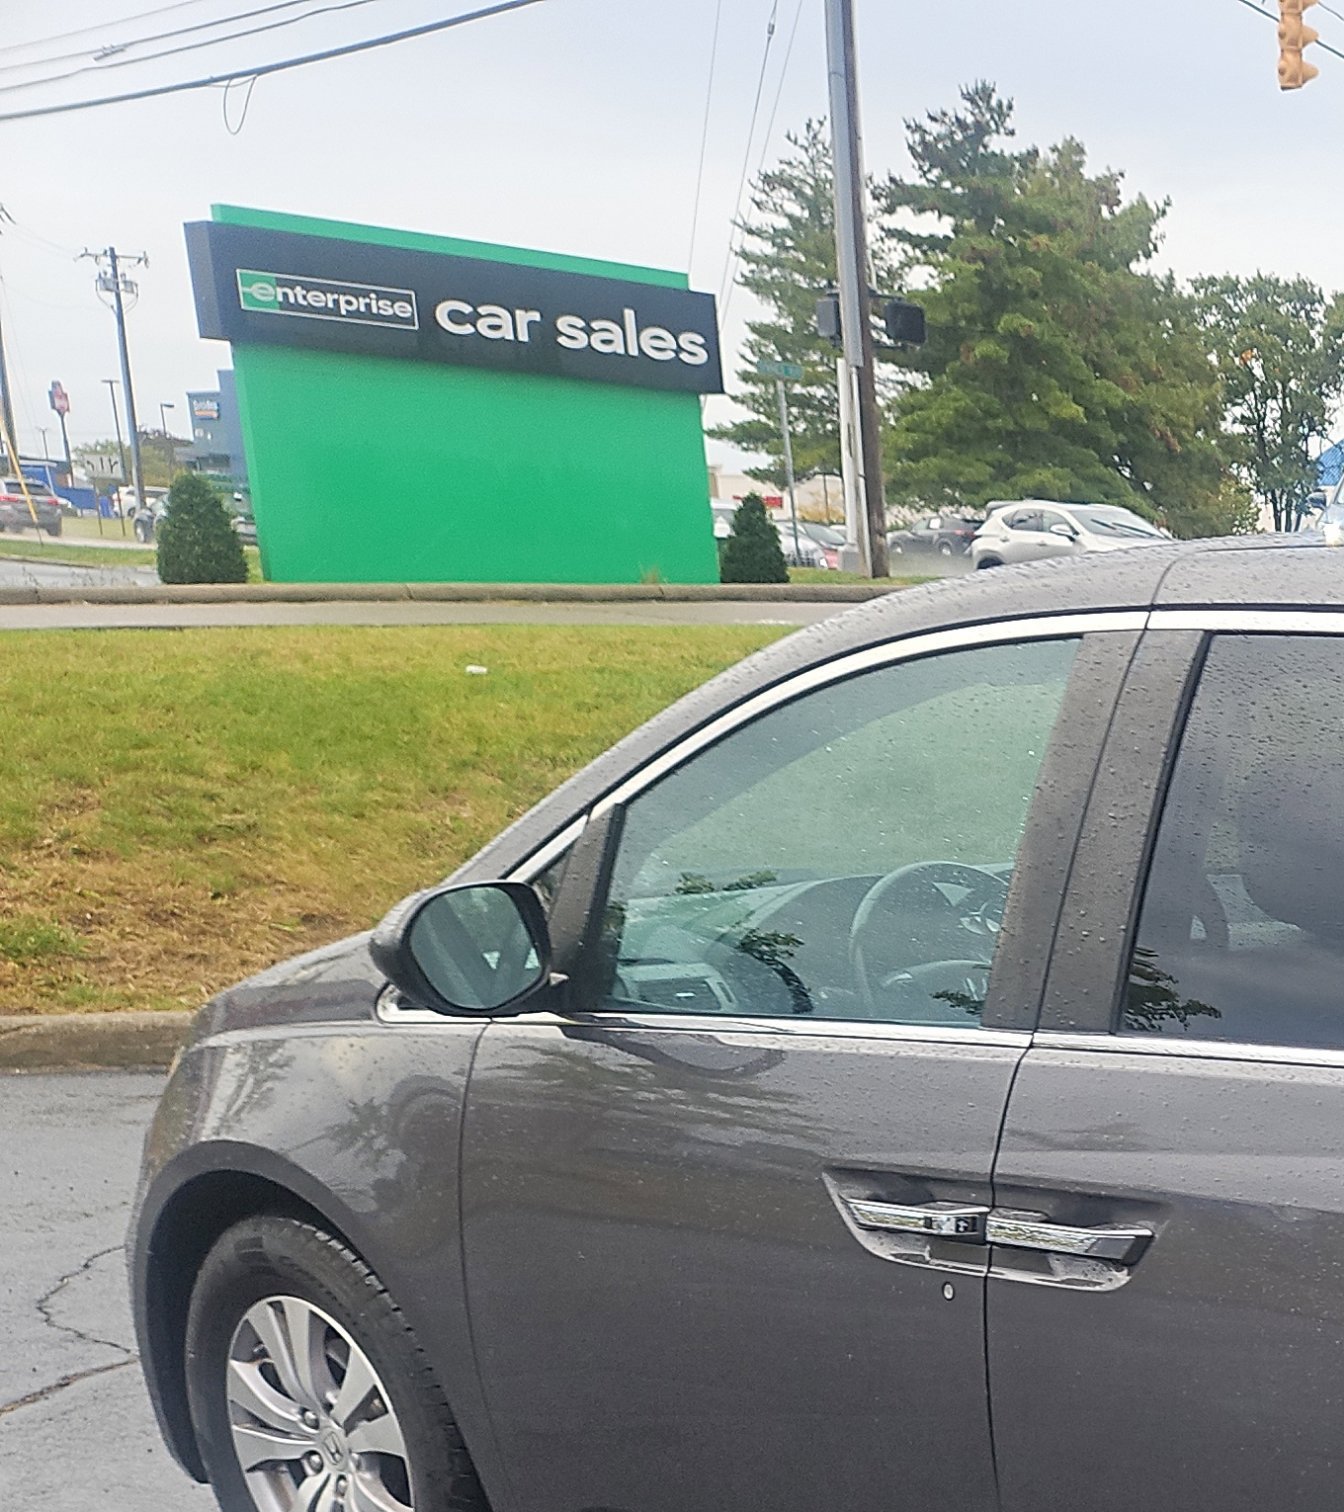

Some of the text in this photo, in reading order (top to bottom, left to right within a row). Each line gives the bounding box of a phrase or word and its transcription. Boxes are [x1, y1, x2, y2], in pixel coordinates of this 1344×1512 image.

[247, 281, 413, 319] enterprise
[434, 298, 709, 366] car sales
